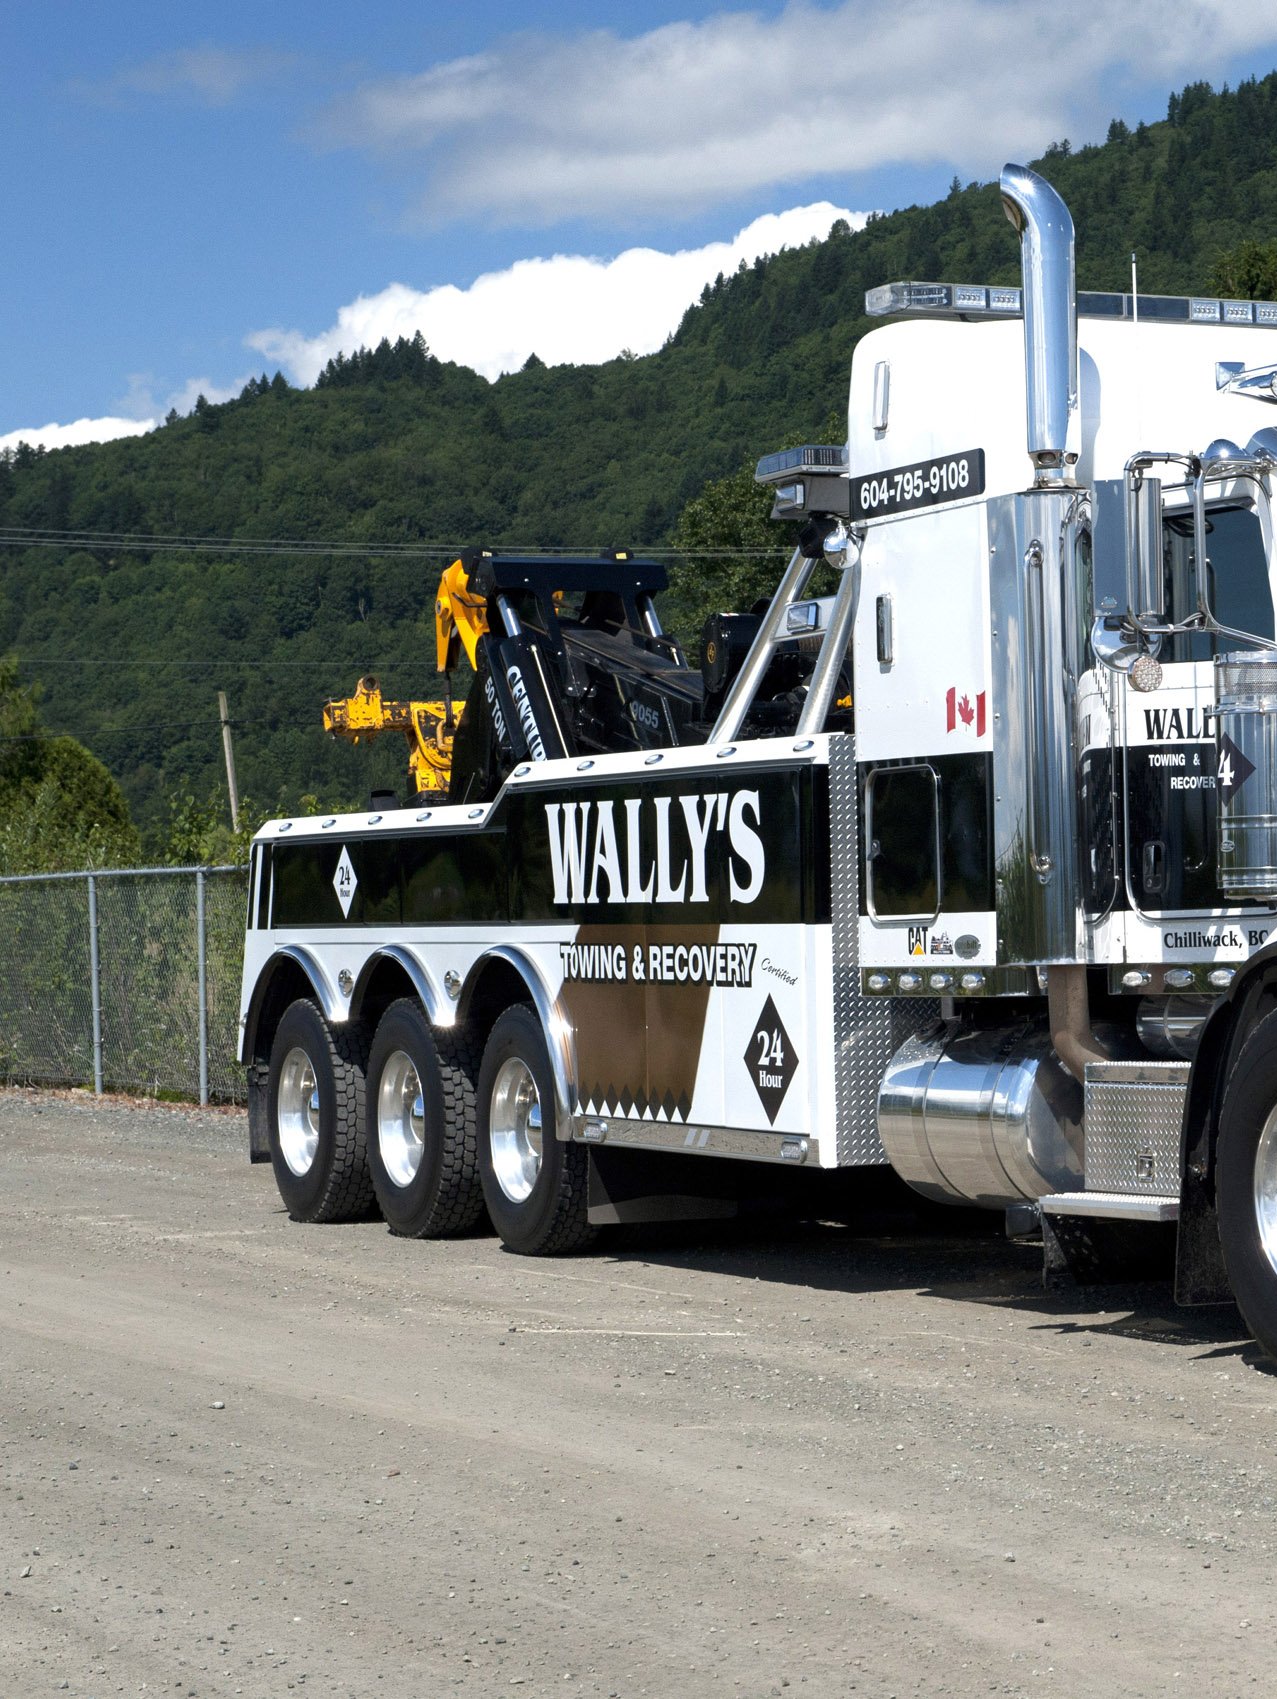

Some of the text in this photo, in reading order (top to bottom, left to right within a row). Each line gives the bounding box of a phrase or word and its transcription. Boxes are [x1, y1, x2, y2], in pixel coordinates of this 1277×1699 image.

[861, 459, 969, 510] 604-795-9108
[491, 698, 506, 742] TON
[1148, 753, 1186, 767] TOWING
[1170, 776, 1216, 789] RECOVER
[545, 790, 765, 904] WALLY'S
[339, 865, 351, 885] 24
[908, 927, 928, 955] CAT
[1163, 931, 1243, 949] Chilliwack,
[560, 943, 757, 987] TOWING & RECOVERY
[757, 1028, 784, 1067] 24
[759, 1070, 783, 1089] Hour
